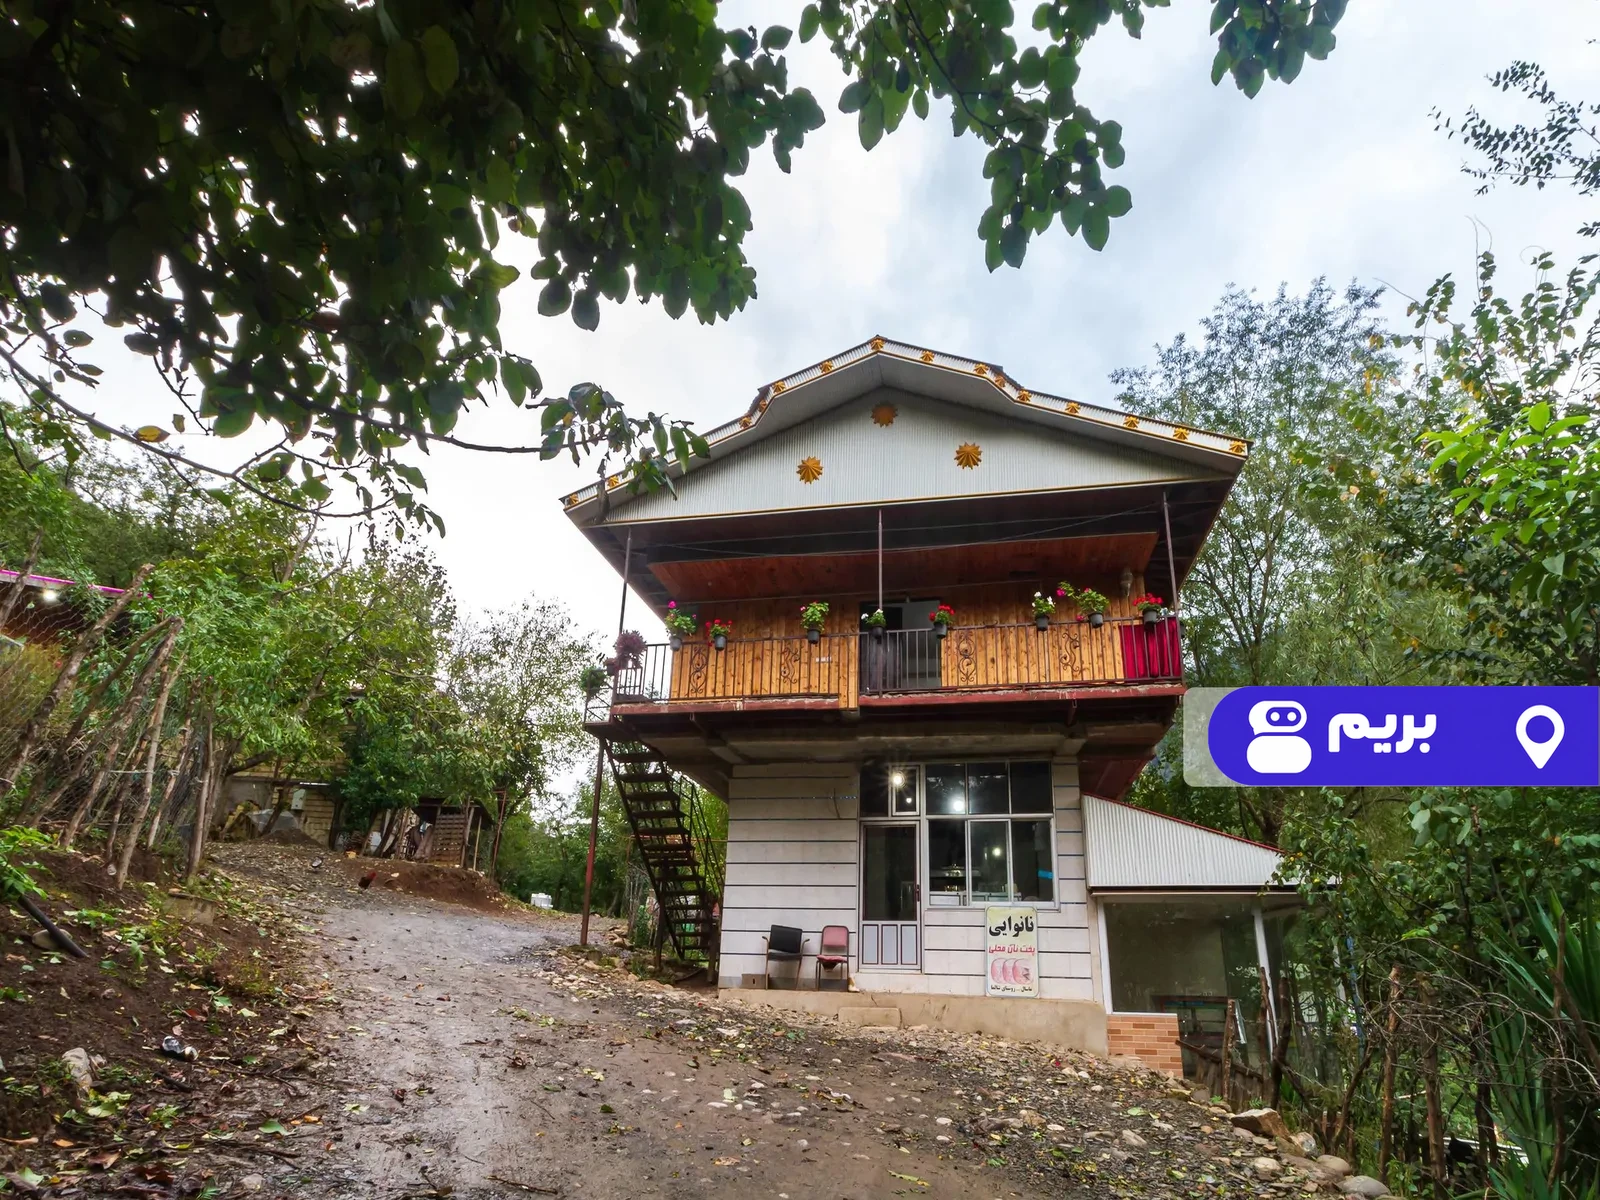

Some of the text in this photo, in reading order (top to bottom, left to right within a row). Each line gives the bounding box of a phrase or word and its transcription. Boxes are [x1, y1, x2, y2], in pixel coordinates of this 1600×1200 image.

[989, 915, 1034, 938] نانوایی
[988, 943, 1036, 956] پخت نان محلی
